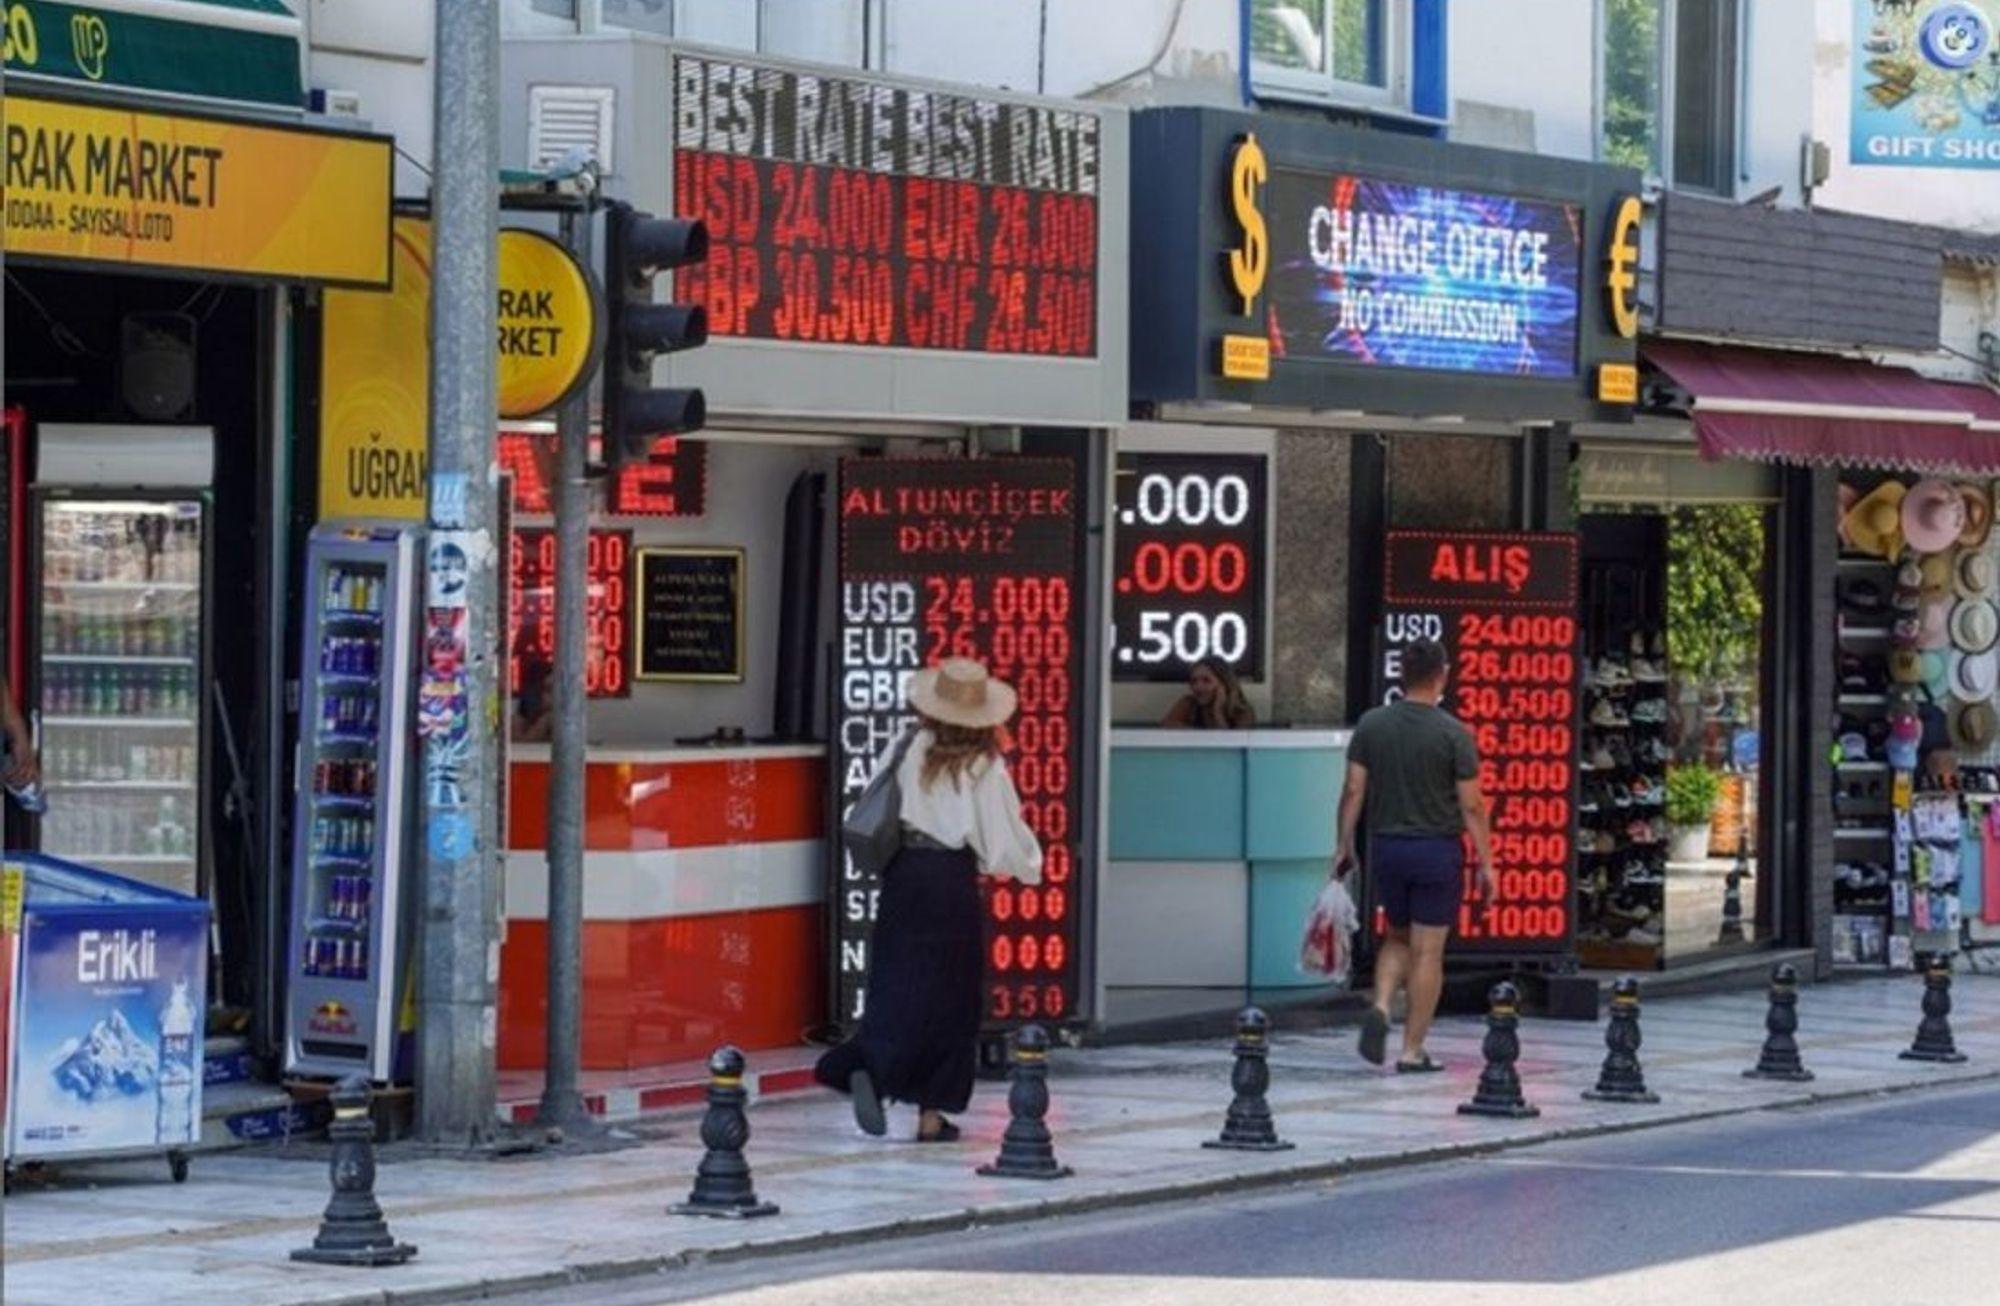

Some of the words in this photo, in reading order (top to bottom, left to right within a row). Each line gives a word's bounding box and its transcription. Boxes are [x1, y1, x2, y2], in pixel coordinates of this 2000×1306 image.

[678, 58, 784, 158] BEST
[796, 76, 896, 173] RATE
[906, 90, 1000, 183] BEST
[1009, 104, 1096, 193] RATE
[1868, 135, 1935, 158] GIFT
[86, 133, 222, 208] MARKET
[676, 150, 760, 244] USD
[773, 163, 893, 253] 24.000
[905, 179, 981, 263] EUR
[1308, 206, 1437, 274] CHANGE
[1446, 221, 1549, 287] OFFICE
[906, 262, 978, 349] CHF
[1340, 287, 1374, 332] NO
[1380, 292, 1518, 342] COMMISSION
[1431, 543, 1530, 593] ALIŞ
[844, 583, 915, 622] USD
[926, 577, 1069, 622] 24.000
[844, 627, 919, 665] EUR
[1386, 613, 1443, 642] USD
[1458, 614, 1575, 647] 24.000
[1457, 650, 1573, 683] 26.000
[78, 929, 155, 982] Erikli
